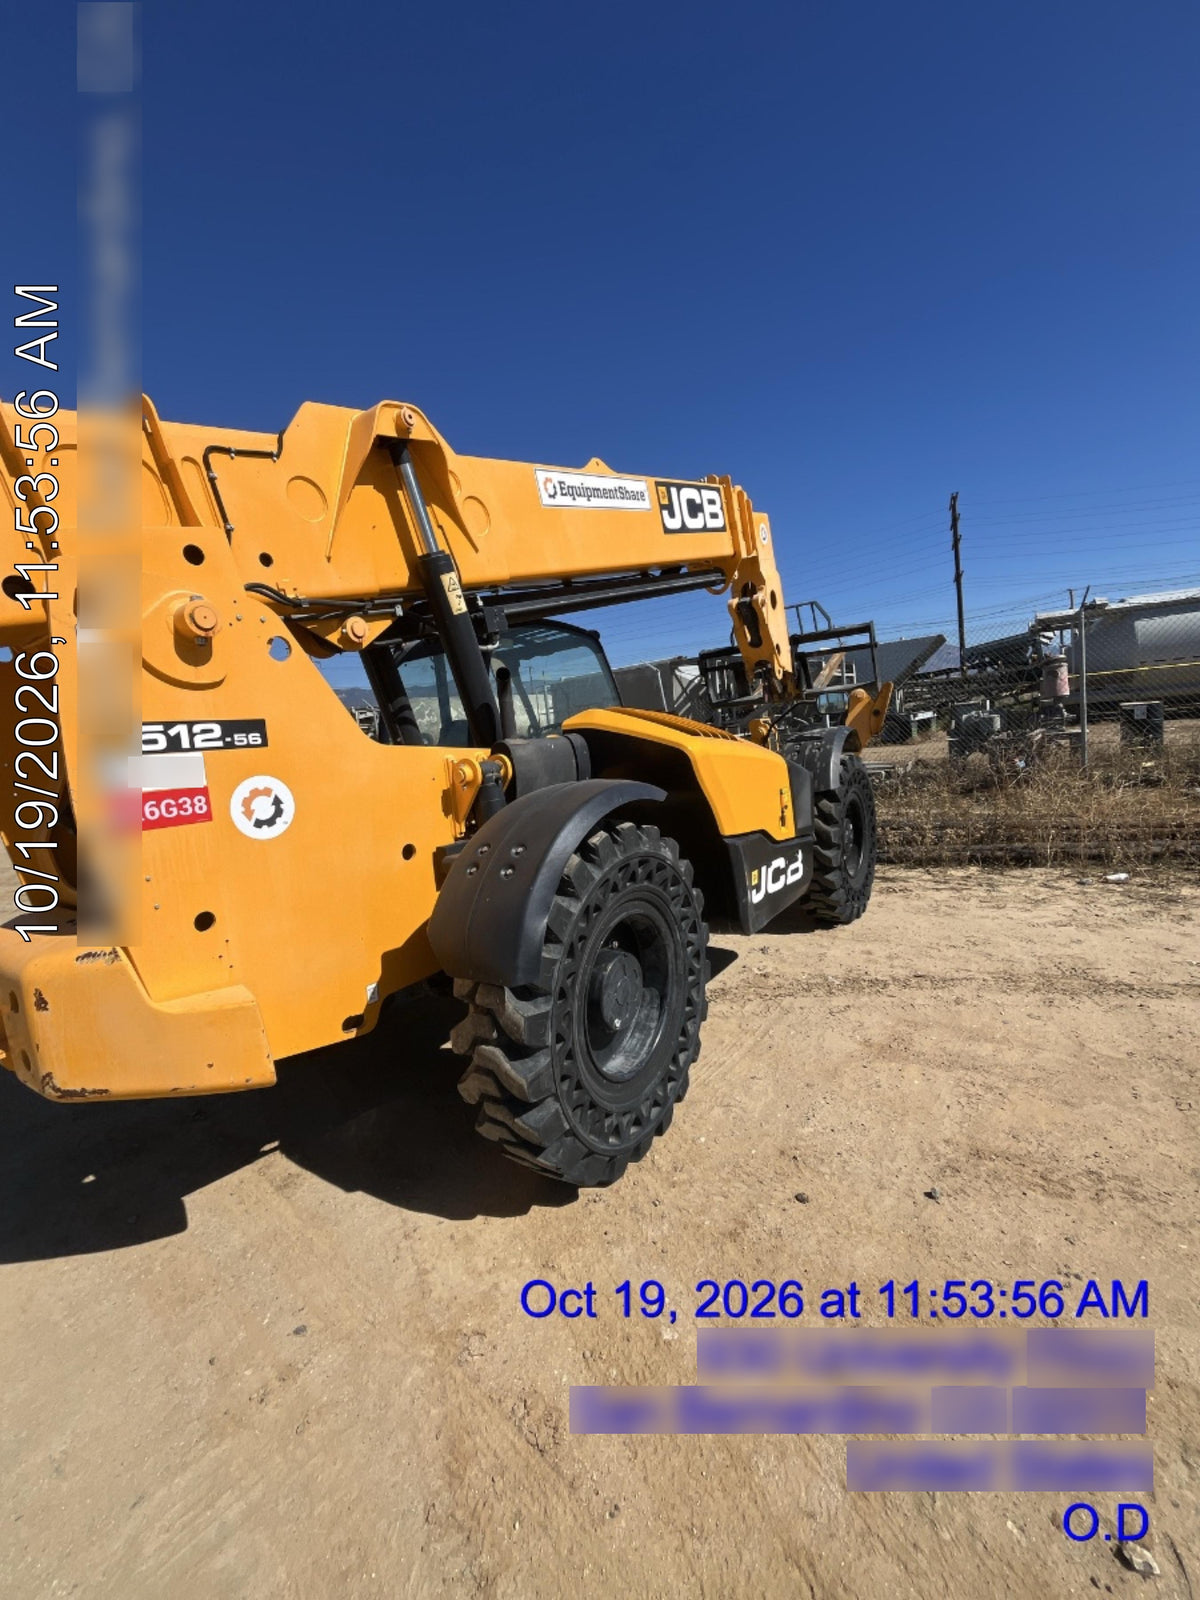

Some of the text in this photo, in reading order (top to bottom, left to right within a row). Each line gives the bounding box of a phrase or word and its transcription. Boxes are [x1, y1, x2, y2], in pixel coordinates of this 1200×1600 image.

[557, 480, 646, 502] EquipmentShare
[661, 486, 725, 530] JCB
[142, 795, 208, 821] 6G38
